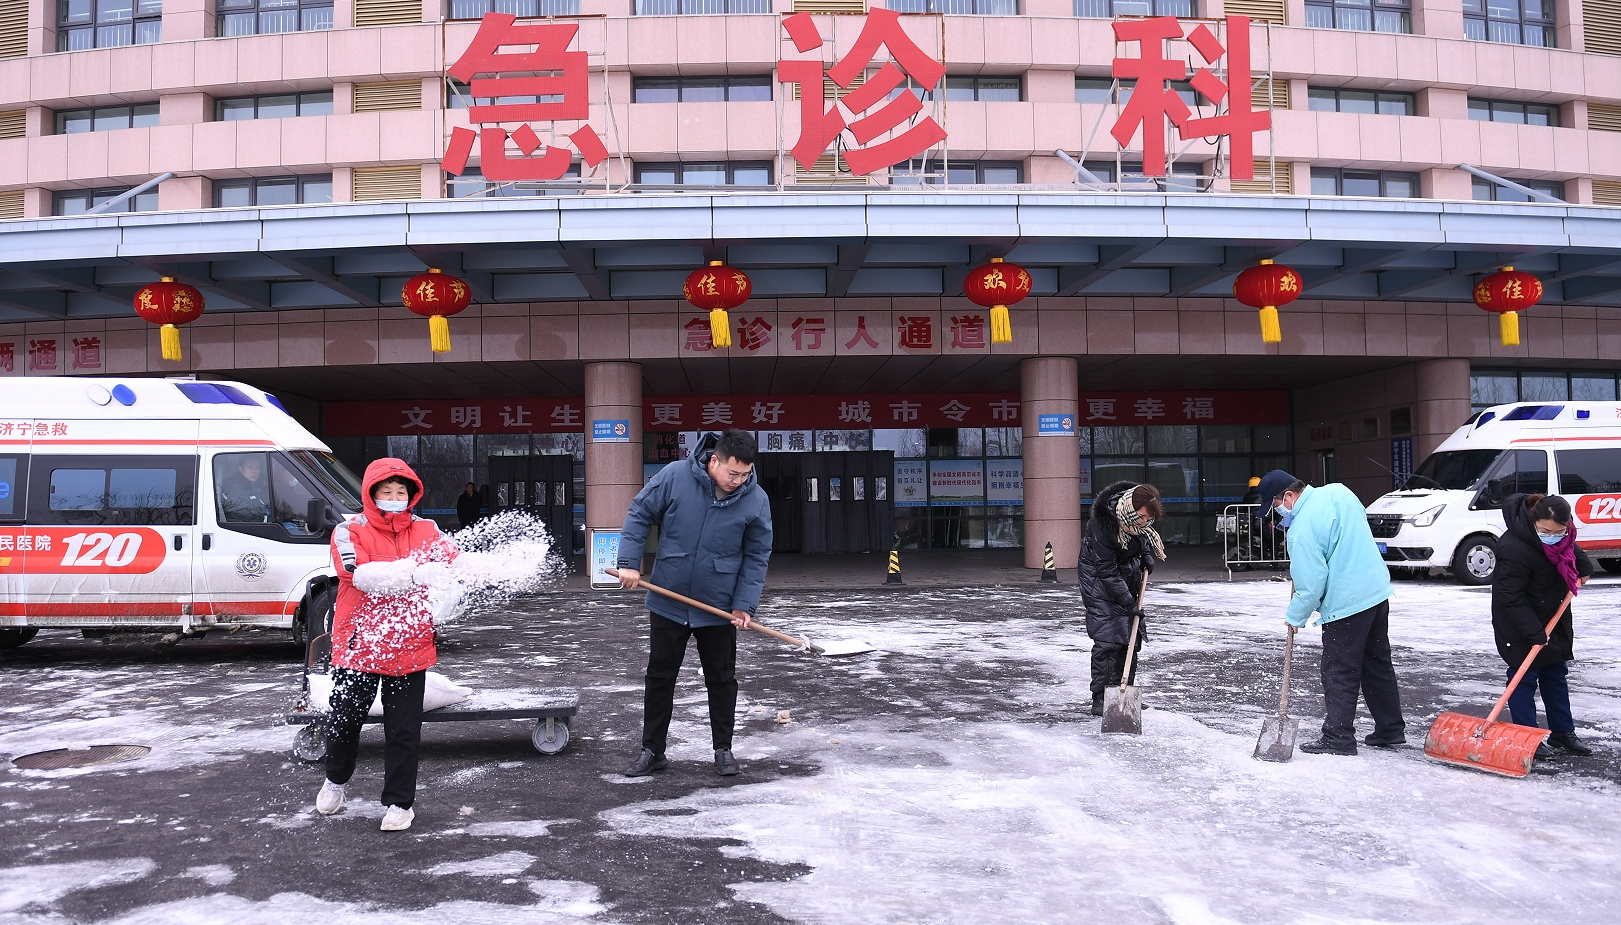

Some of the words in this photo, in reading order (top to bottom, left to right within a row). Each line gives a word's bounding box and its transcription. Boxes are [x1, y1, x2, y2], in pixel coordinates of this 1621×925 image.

[441, 7, 1271, 181] 急诊科
[416, 279, 466, 303] 佳节
[697, 272, 747, 296] 佳节
[684, 315, 987, 351] 急诊行人通道
[654, 433, 686, 445] 消化道
[648, 447, 691, 459] 出血中心
[0, 535, 52, 552] 民医院
[60, 532, 143, 567] 120
[609, 536, 618, 572] 患者下车
